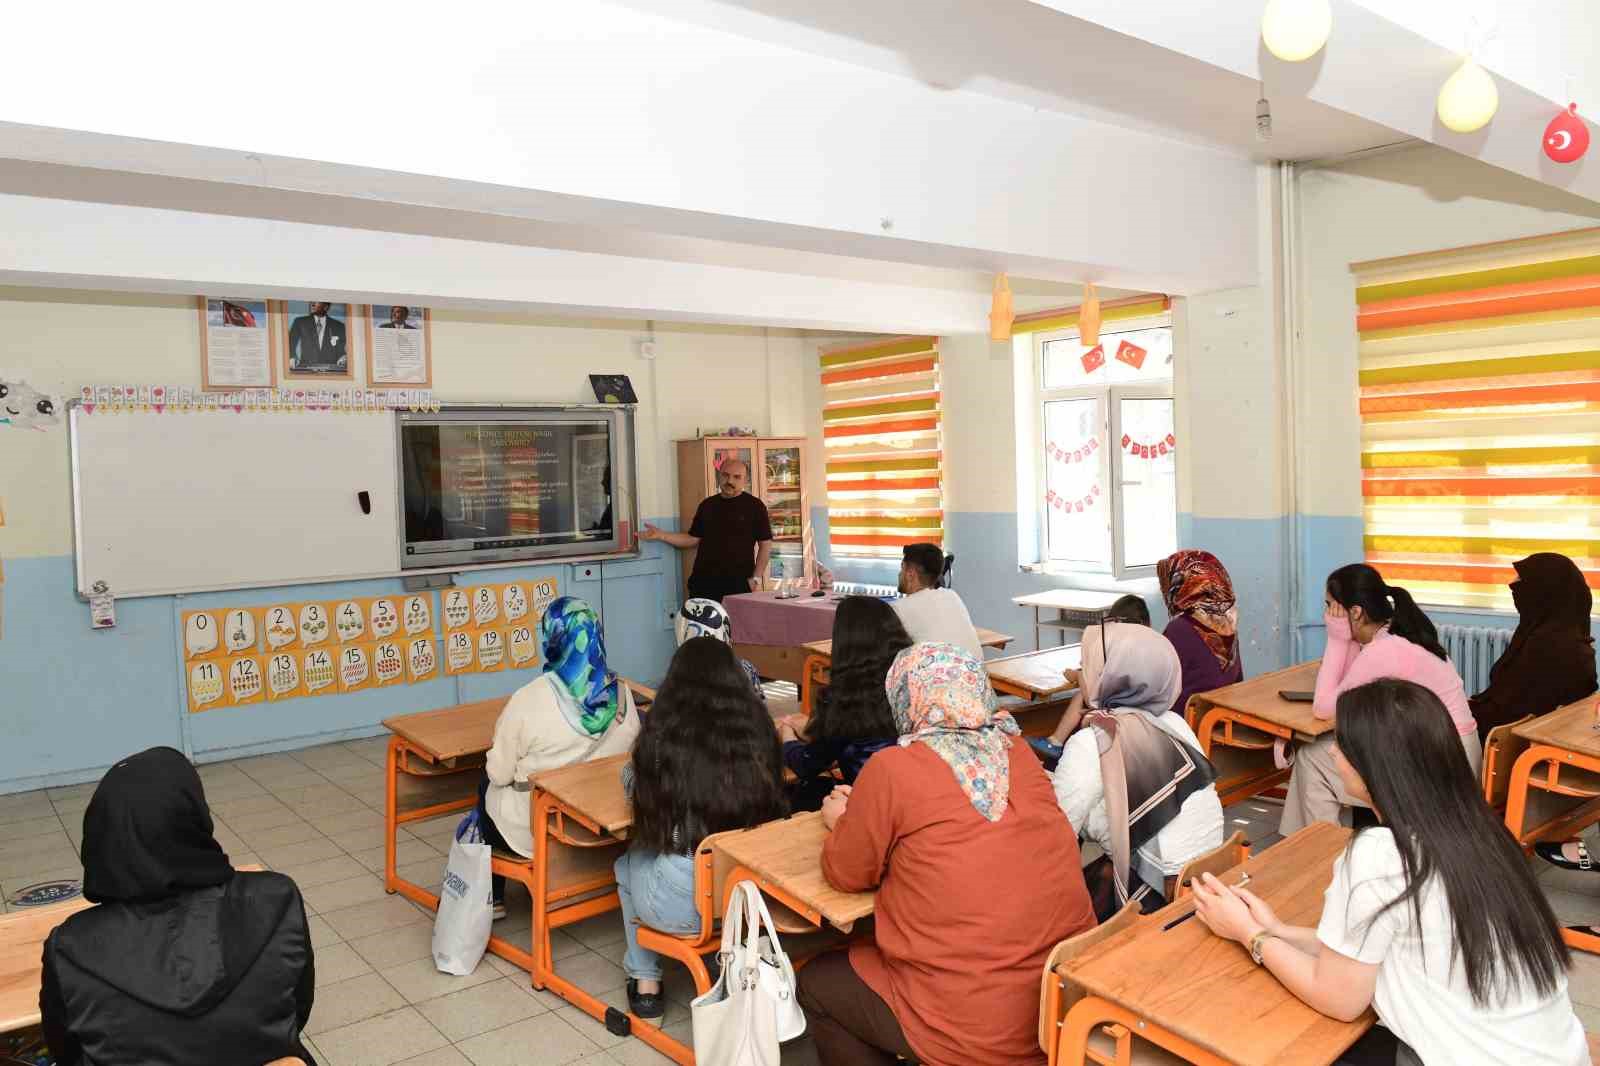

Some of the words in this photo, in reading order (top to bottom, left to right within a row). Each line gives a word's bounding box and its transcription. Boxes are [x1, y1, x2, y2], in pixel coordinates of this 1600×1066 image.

[480, 588, 489, 602] 8
[510, 585, 517, 599] 9
[535, 582, 550, 597] 10
[411, 598, 420, 612] 6
[453, 591, 461, 605] 7
[308, 606, 318, 621] 3
[343, 603, 355, 616] 4
[378, 600, 388, 615] 5
[196, 614, 207, 630] 0
[236, 611, 243, 626] 1
[273, 608, 284, 624] 2
[453, 634, 467, 648] 18
[485, 631, 497, 646] 19
[513, 627, 530, 643] 20
[379, 643, 395, 659] 16
[413, 639, 426, 657] 17
[274, 655, 291, 671] 13
[308, 651, 327, 667] 14
[345, 648, 361, 664] 15
[199, 663, 213, 680] 11
[236, 659, 253, 676] 12
